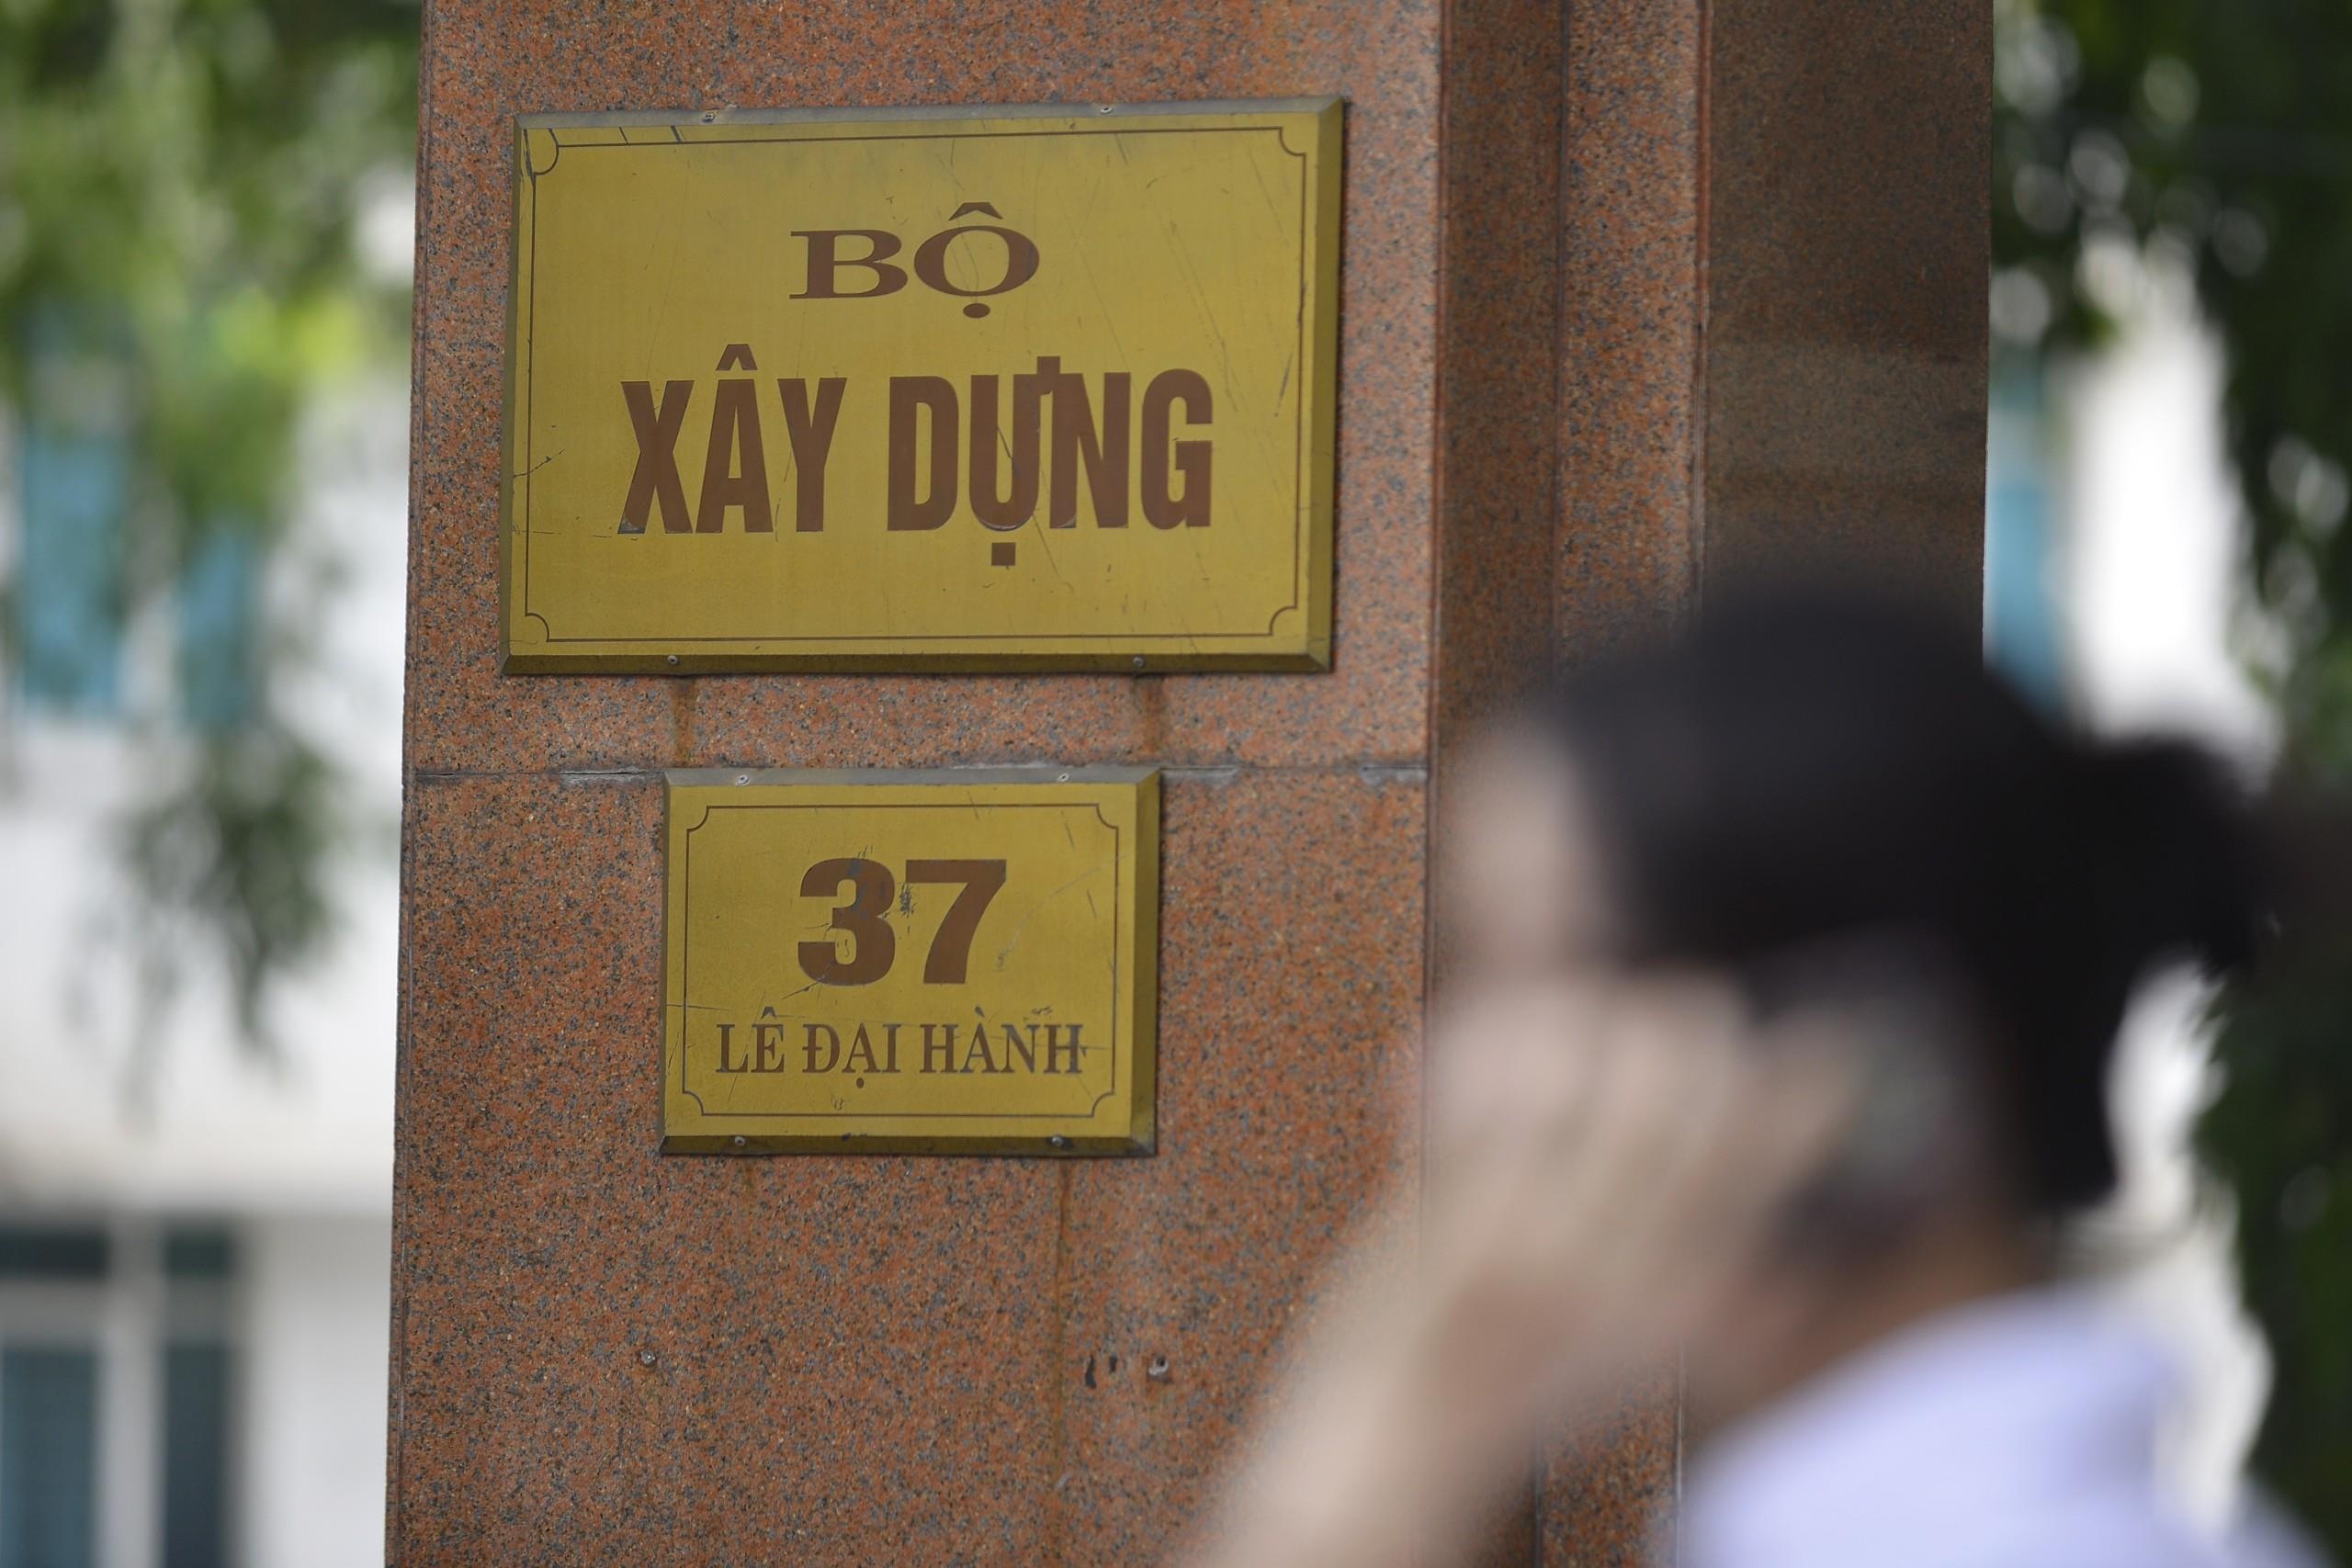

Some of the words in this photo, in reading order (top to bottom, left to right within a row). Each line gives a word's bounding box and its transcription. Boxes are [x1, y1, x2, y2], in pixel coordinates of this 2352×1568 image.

[789, 201, 1040, 319] BỘ
[617, 343, 847, 535] XÂY
[888, 355, 1214, 566] DỰNG
[797, 857, 1007, 987] 37
[715, 1006, 785, 1074] LÊ
[801, 1022, 902, 1089] ĐẠI
[919, 1006, 1083, 1075] HÀNH
